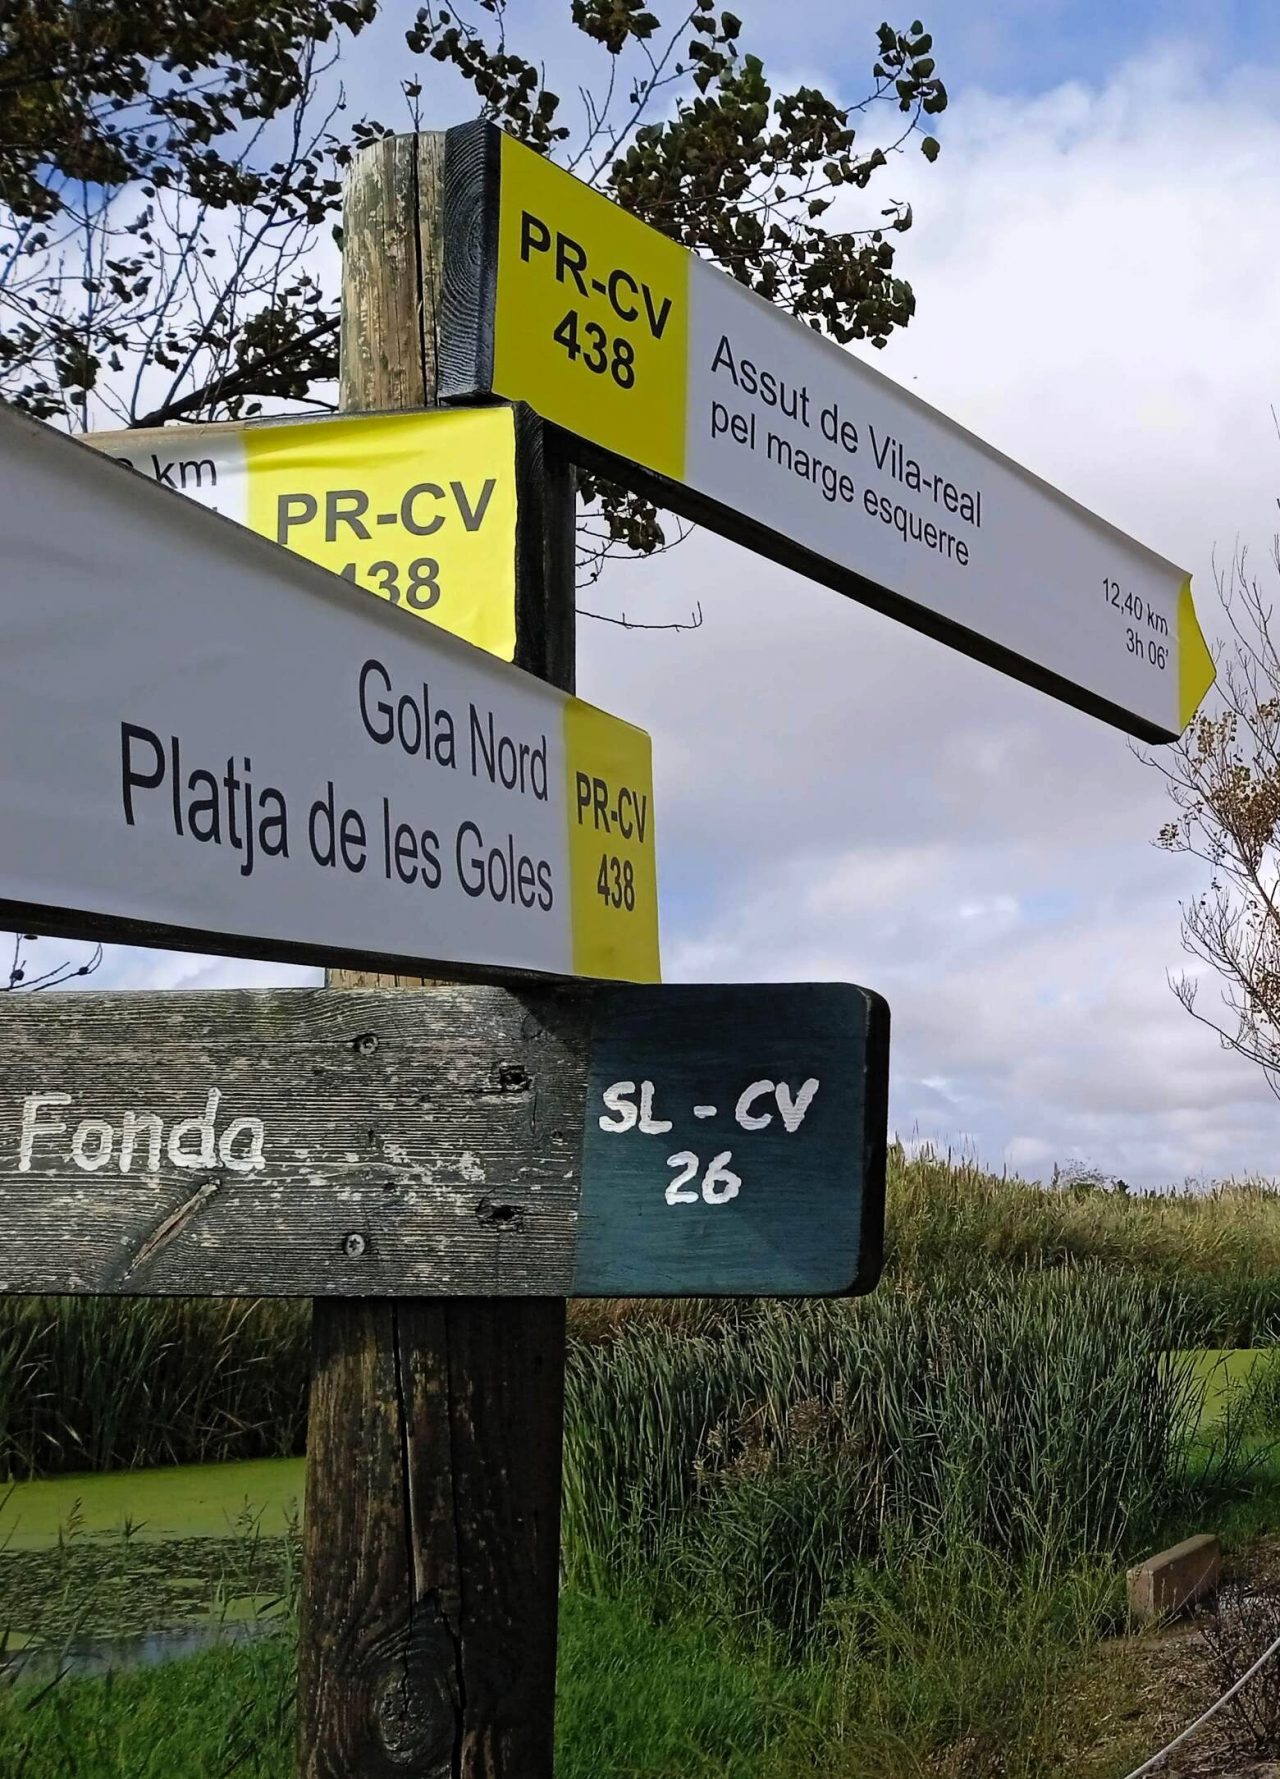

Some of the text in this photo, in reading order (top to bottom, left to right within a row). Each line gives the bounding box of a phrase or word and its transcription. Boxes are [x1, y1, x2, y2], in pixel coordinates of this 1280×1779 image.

[521, 210, 673, 340] PR-CV
[552, 309, 635, 390] 438
[711, 334, 981, 528] Assut de Vila-real
[151, 454, 217, 489] km
[711, 400, 969, 566] pel marge esquerre
[277, 478, 497, 546] PR-CV
[1102, 577, 1169, 637] 12,40 km
[1126, 627, 1144, 659] 3h
[358, 658, 548, 801] Gola Nord
[121, 721, 553, 912] Platja de les Goles
[575, 770, 648, 844] PR-CV
[596, 853, 636, 913] 438
[18, 1086, 266, 1172] Fonda
[598, 1080, 674, 1135] SL
[735, 1077, 820, 1133] CV
[664, 1150, 742, 1206] 26
